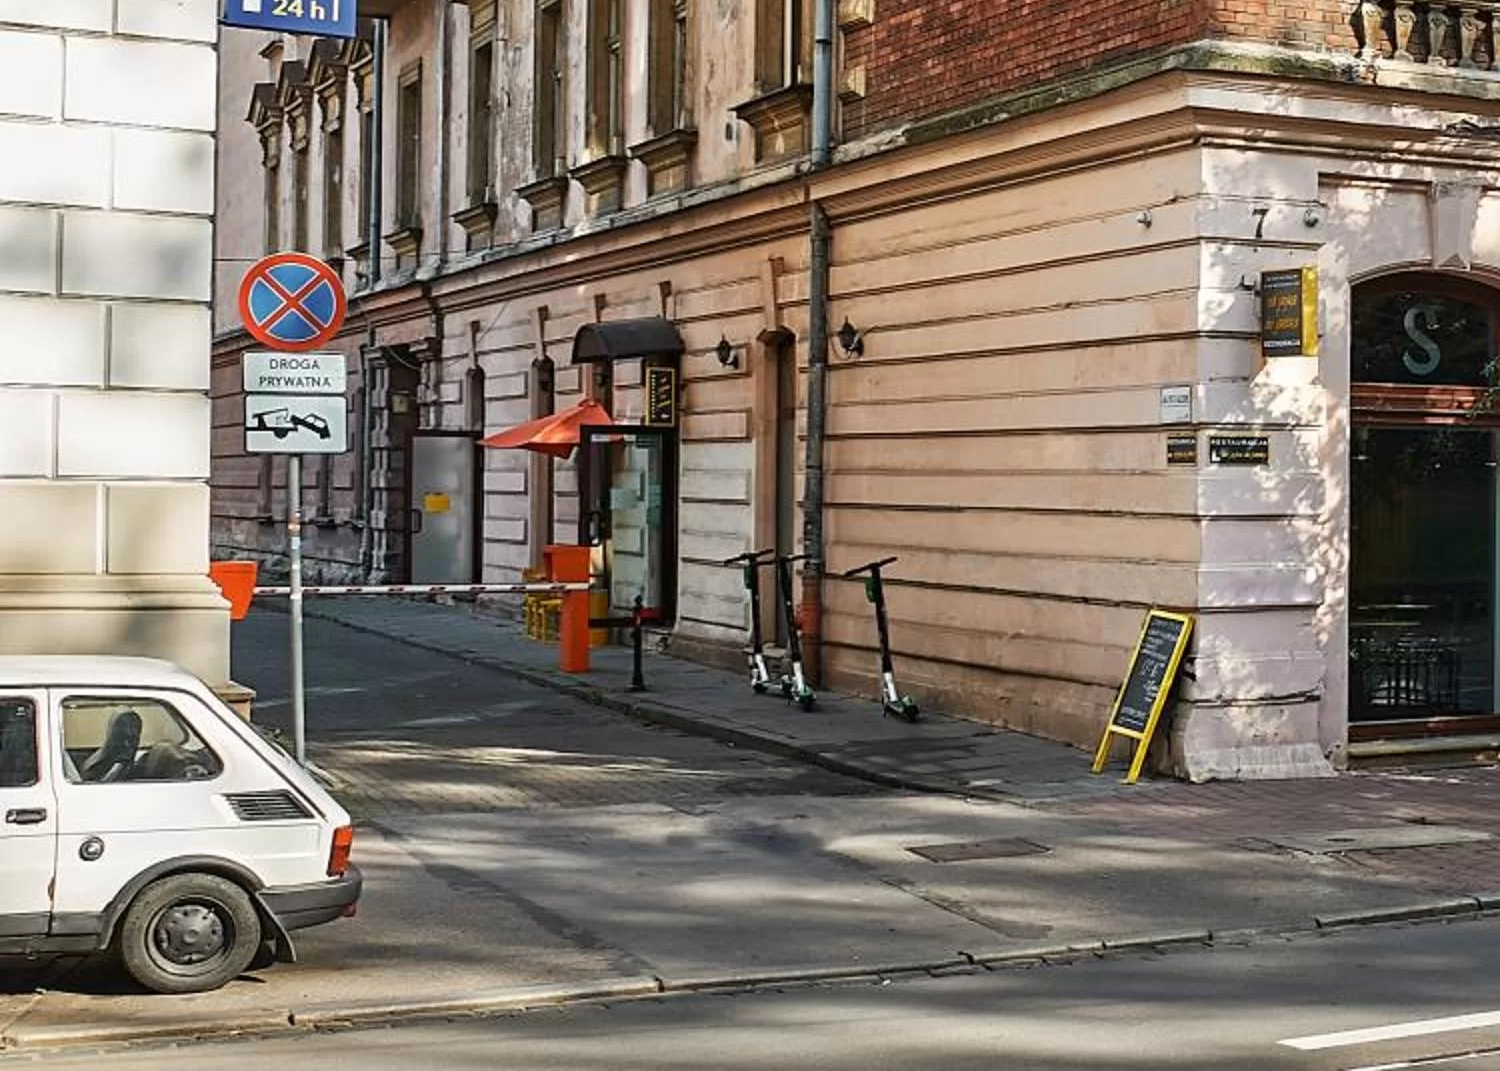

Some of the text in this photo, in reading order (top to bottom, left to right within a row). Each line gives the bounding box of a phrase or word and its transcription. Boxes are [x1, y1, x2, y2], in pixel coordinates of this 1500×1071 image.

[310, 0, 325, 20] h
[1252, 208, 1269, 238] 7
[1402, 305, 1441, 376] S
[269, 358, 321, 370] DROGA
[258, 376, 332, 387] PRYWATNA
